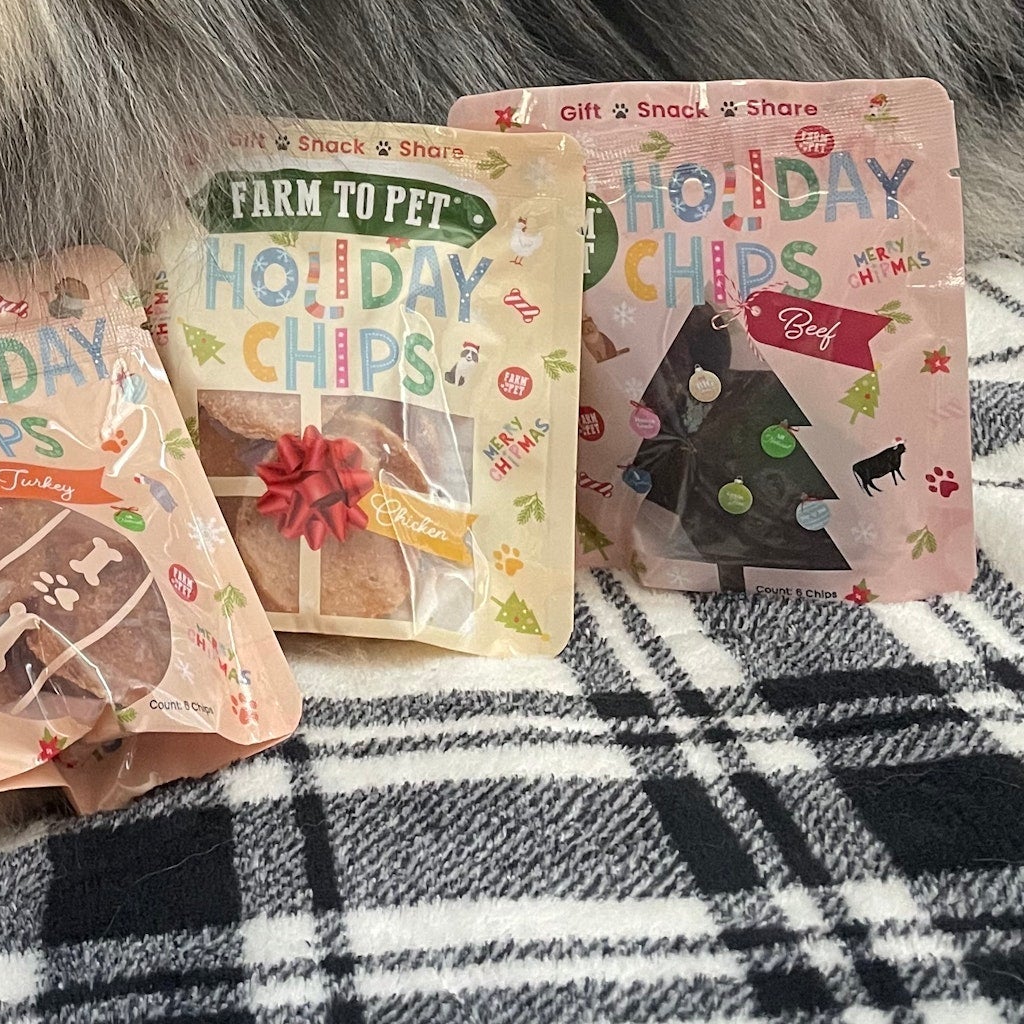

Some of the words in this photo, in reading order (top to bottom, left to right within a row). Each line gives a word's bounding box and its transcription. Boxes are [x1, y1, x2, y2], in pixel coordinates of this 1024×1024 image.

[560, 103, 602, 122] Gift
[637, 100, 709, 119] Snack
[746, 98, 818, 117] Share
[228, 132, 267, 150] Gift
[298, 134, 365, 156] Snack
[399, 139, 465, 160] Share
[230, 178, 323, 220] FARM
[333, 180, 376, 221] TO
[383, 184, 451, 230] PET
[622, 148, 915, 234] HOLIDAY
[624, 232, 821, 310] CHIPS
[853, 237, 904, 268] MERRY
[205, 236, 494, 324] HOLIDAY
[777, 306, 843, 352] Beef
[242, 316, 436, 397] CHIPS
[504, 371, 529, 387] FARM
[508, 384, 526, 397] PET
[579, 412, 598, 425] ARM
[483, 416, 523, 461] MERRY
[371, 492, 450, 542] Chicken
[796, 588, 803, 597] 6
[805, 588, 838, 600] Chips
[191, 701, 215, 715] Chips
